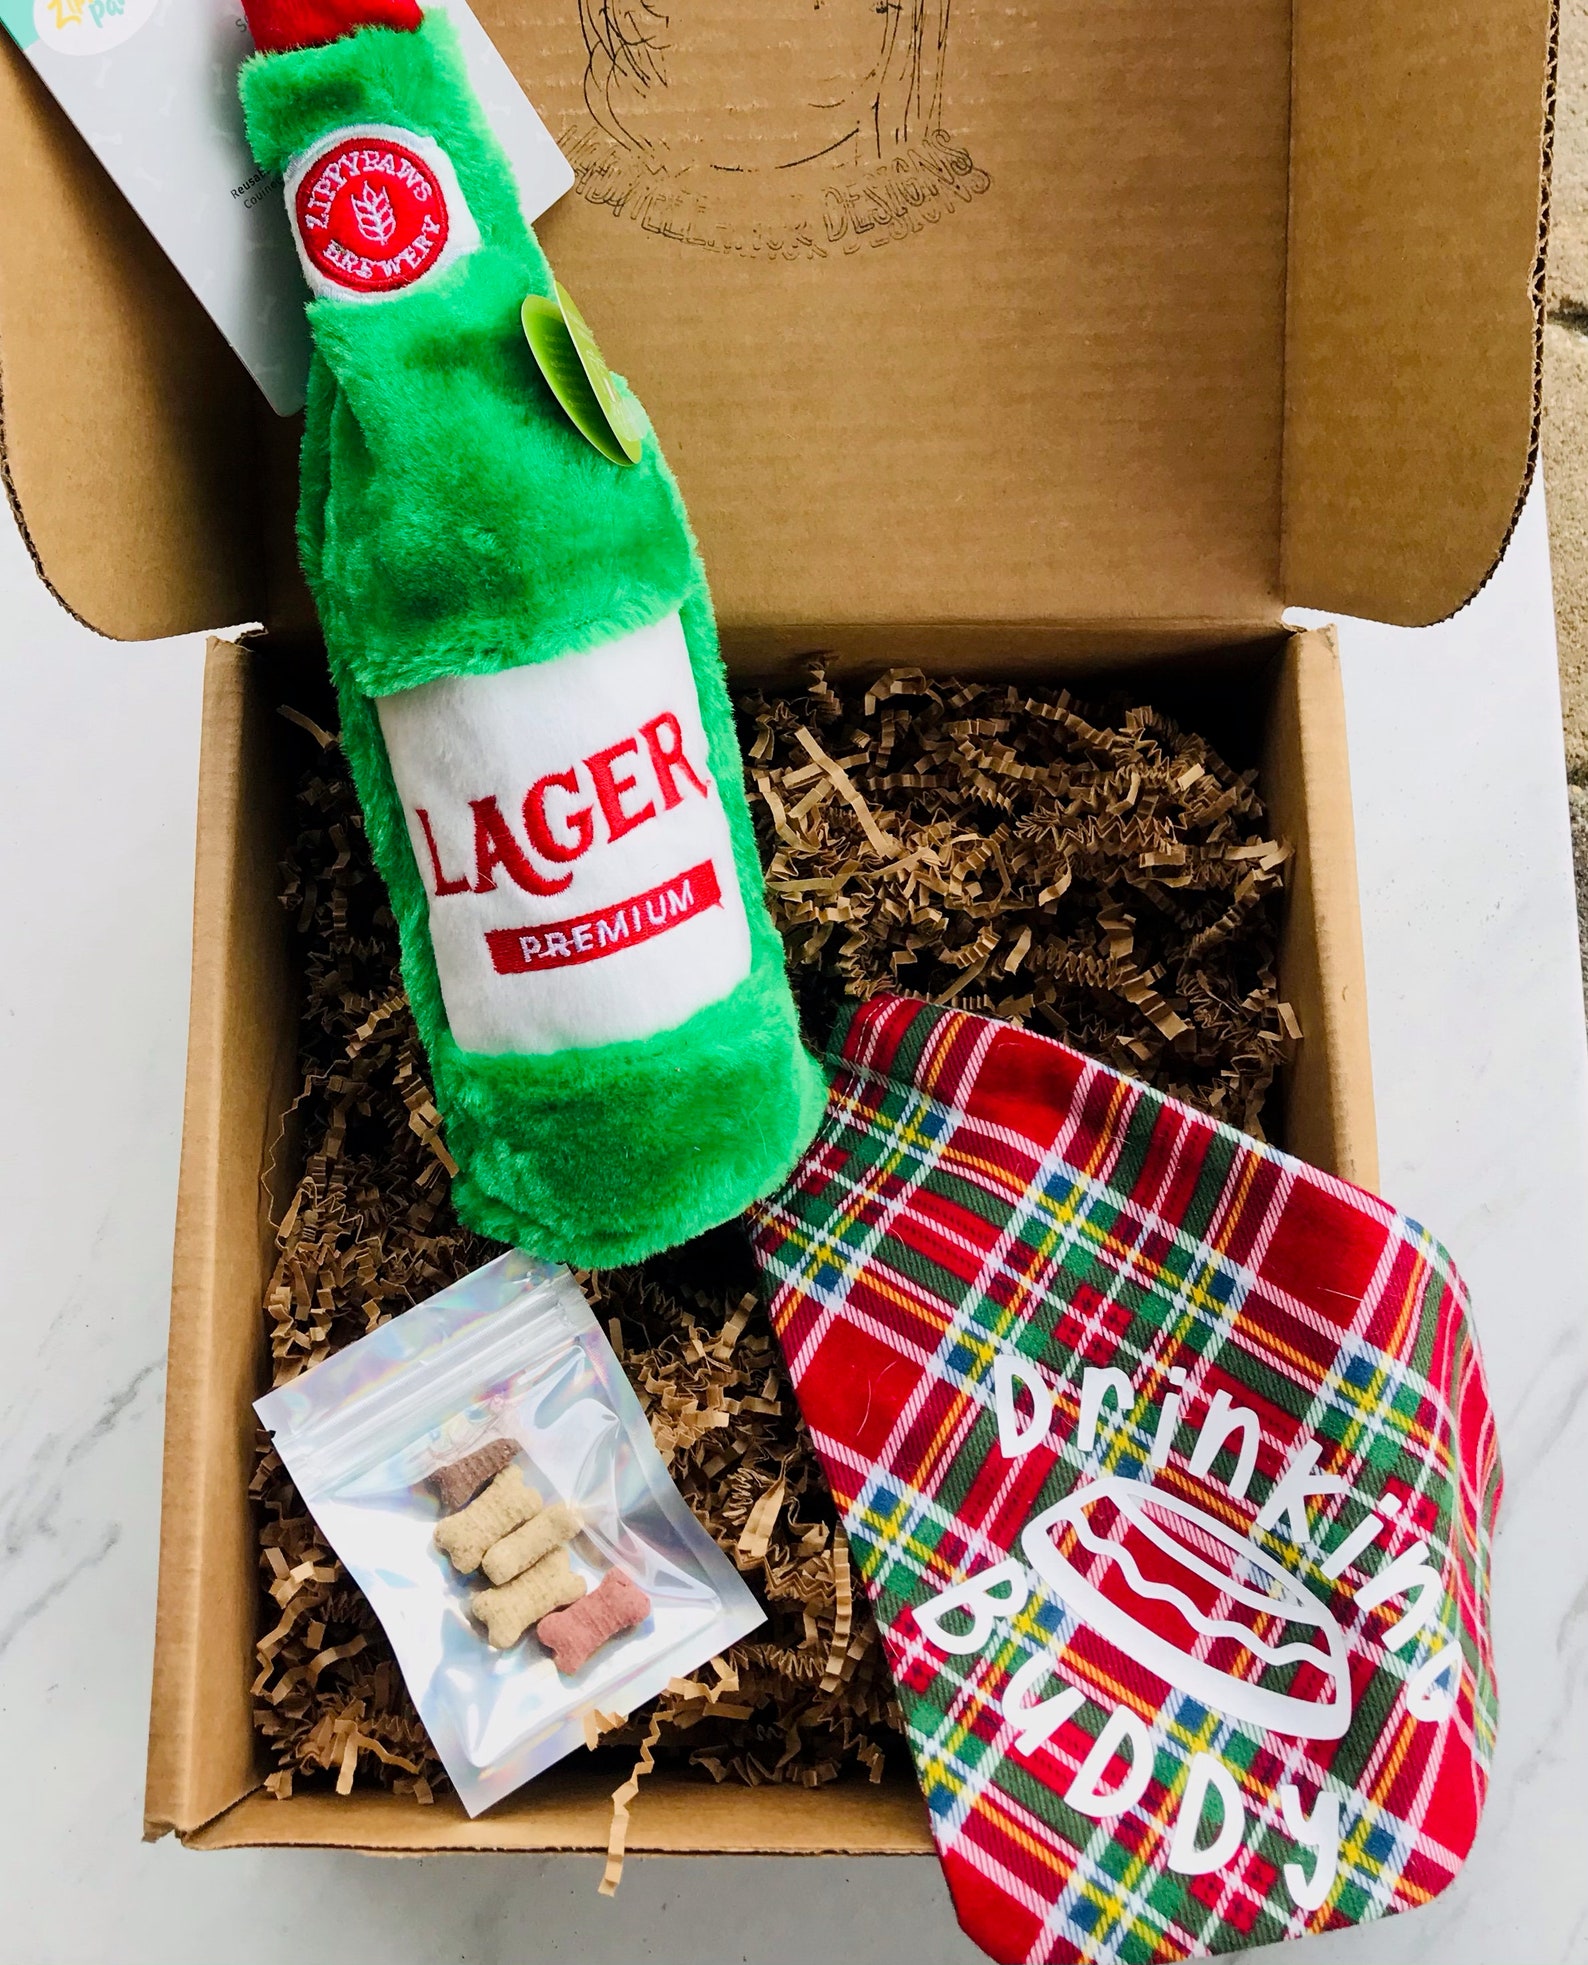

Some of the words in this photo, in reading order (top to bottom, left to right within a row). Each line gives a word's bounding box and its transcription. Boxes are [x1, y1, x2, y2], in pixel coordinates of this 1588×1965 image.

[322, 214, 441, 279] BREWERY
[415, 710, 709, 898] LAGER
[518, 878, 695, 963] PREMIUM
